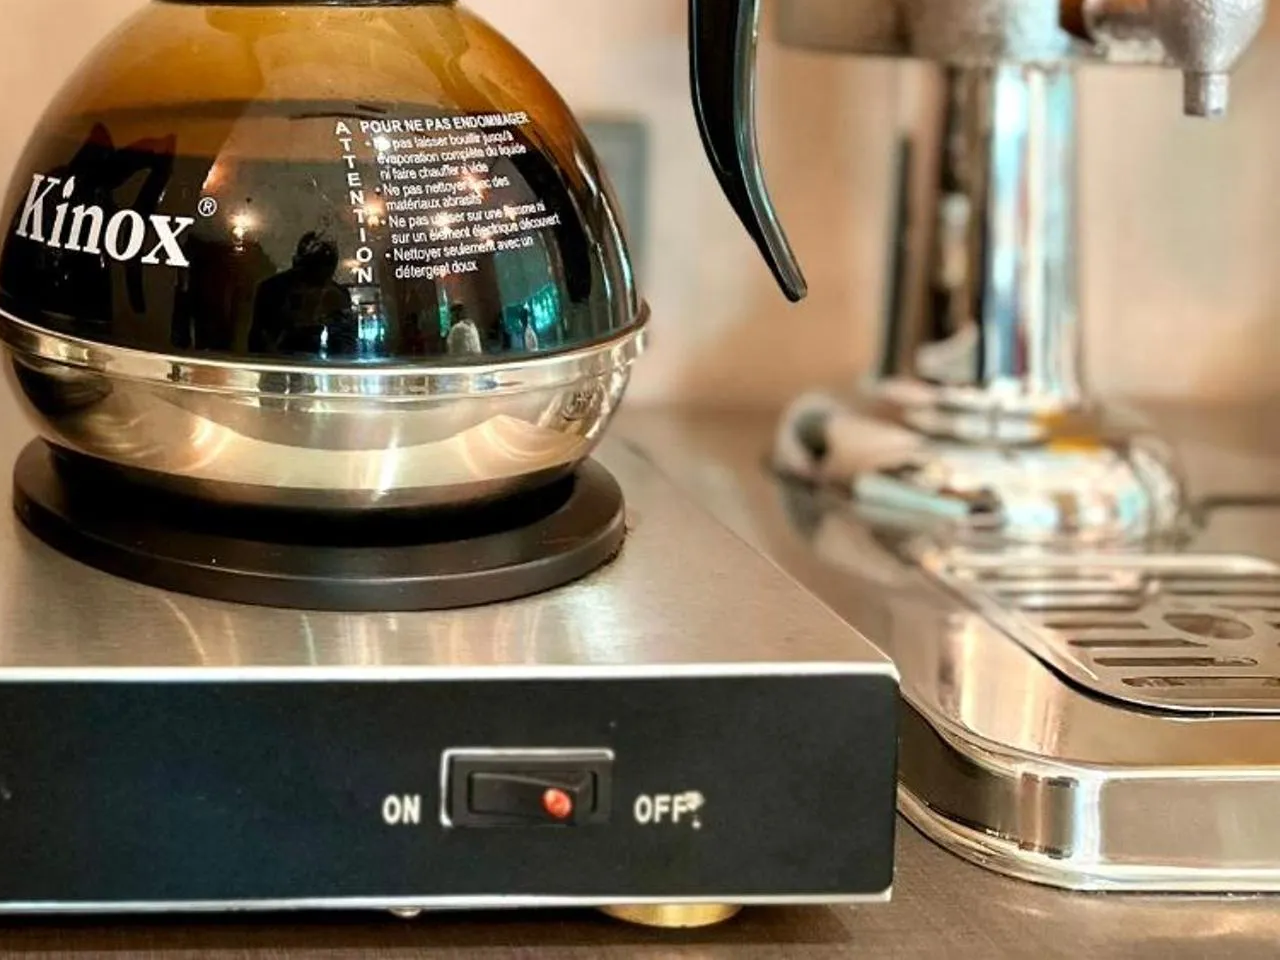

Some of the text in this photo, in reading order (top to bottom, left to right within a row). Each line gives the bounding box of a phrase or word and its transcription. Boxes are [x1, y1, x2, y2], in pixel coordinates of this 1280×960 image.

[360, 120, 403, 133] POUR
[404, 119, 424, 131] NE
[425, 117, 452, 131] PAS
[392, 139, 413, 151] pas
[485, 145, 498, 157] du
[392, 166, 417, 180] faire
[383, 183, 400, 196] Ne
[402, 184, 423, 197] pas
[491, 176, 510, 189] des
[16, 172, 195, 269] Kinox
[389, 215, 407, 228] Ne
[409, 215, 429, 230] pas
[466, 210, 482, 222] sur
[484, 209, 503, 221] une
[391, 232, 410, 244] sur
[412, 231, 428, 243] un
[394, 236, 534, 263] Nettoyer seulement avec un
[451, 260, 478, 274] doux
[382, 795, 421, 824] ON
[633, 794, 692, 823] OFF
